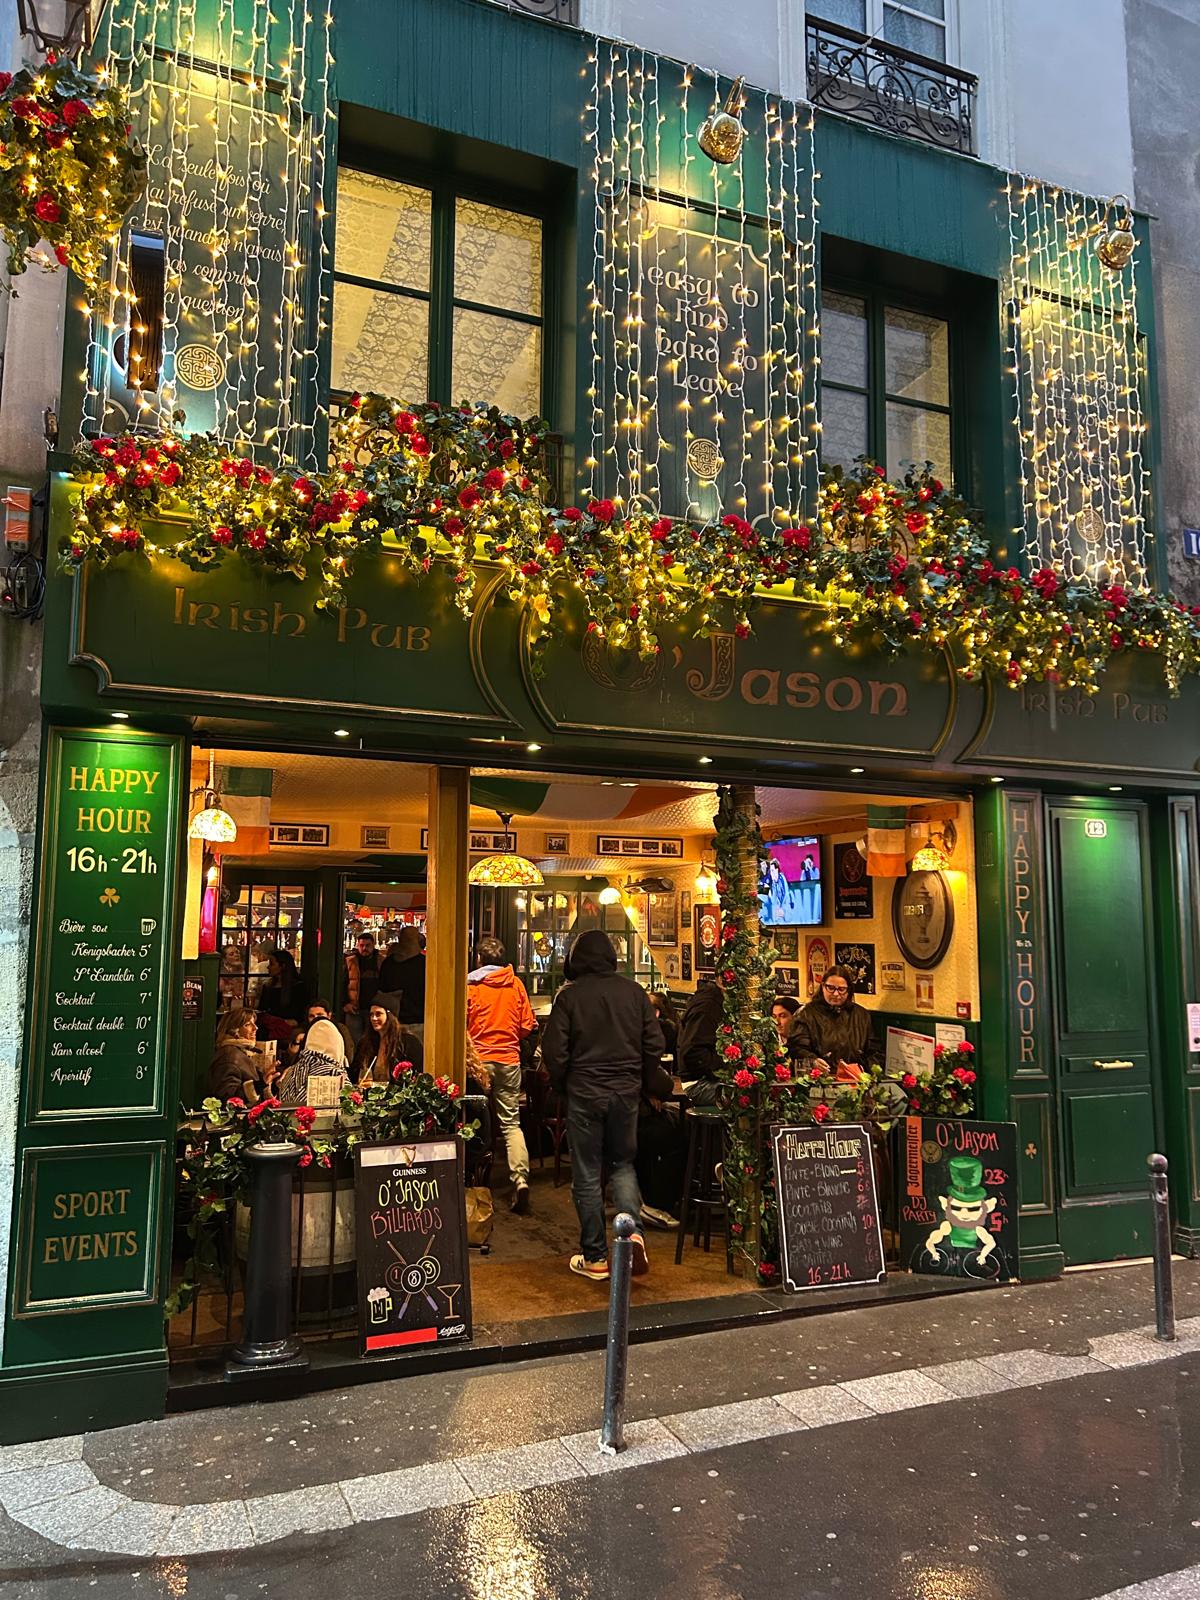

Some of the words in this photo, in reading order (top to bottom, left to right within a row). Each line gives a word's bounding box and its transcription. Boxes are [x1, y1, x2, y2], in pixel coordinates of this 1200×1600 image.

[182, 294, 245, 319] question
[68, 766, 160, 794] HAPPY
[75, 806, 152, 834] HOUR
[1012, 808, 1031, 934] HAPPY
[55, 991, 96, 1006] Cocktail
[1016, 953, 1035, 1063] HOUR
[53, 1016, 95, 1031] Cocktail
[96, 1016, 125, 1031] double
[51, 1042, 73, 1057] Sans
[76, 1041, 106, 1056] alcool
[392, 1167, 427, 1177] GUINNESS
[53, 1188, 131, 1219] SPORT
[903, 1205, 937, 1224] PARTY
[911, 1196, 927, 1211] DJ
[42, 1230, 139, 1264] EVENTS
